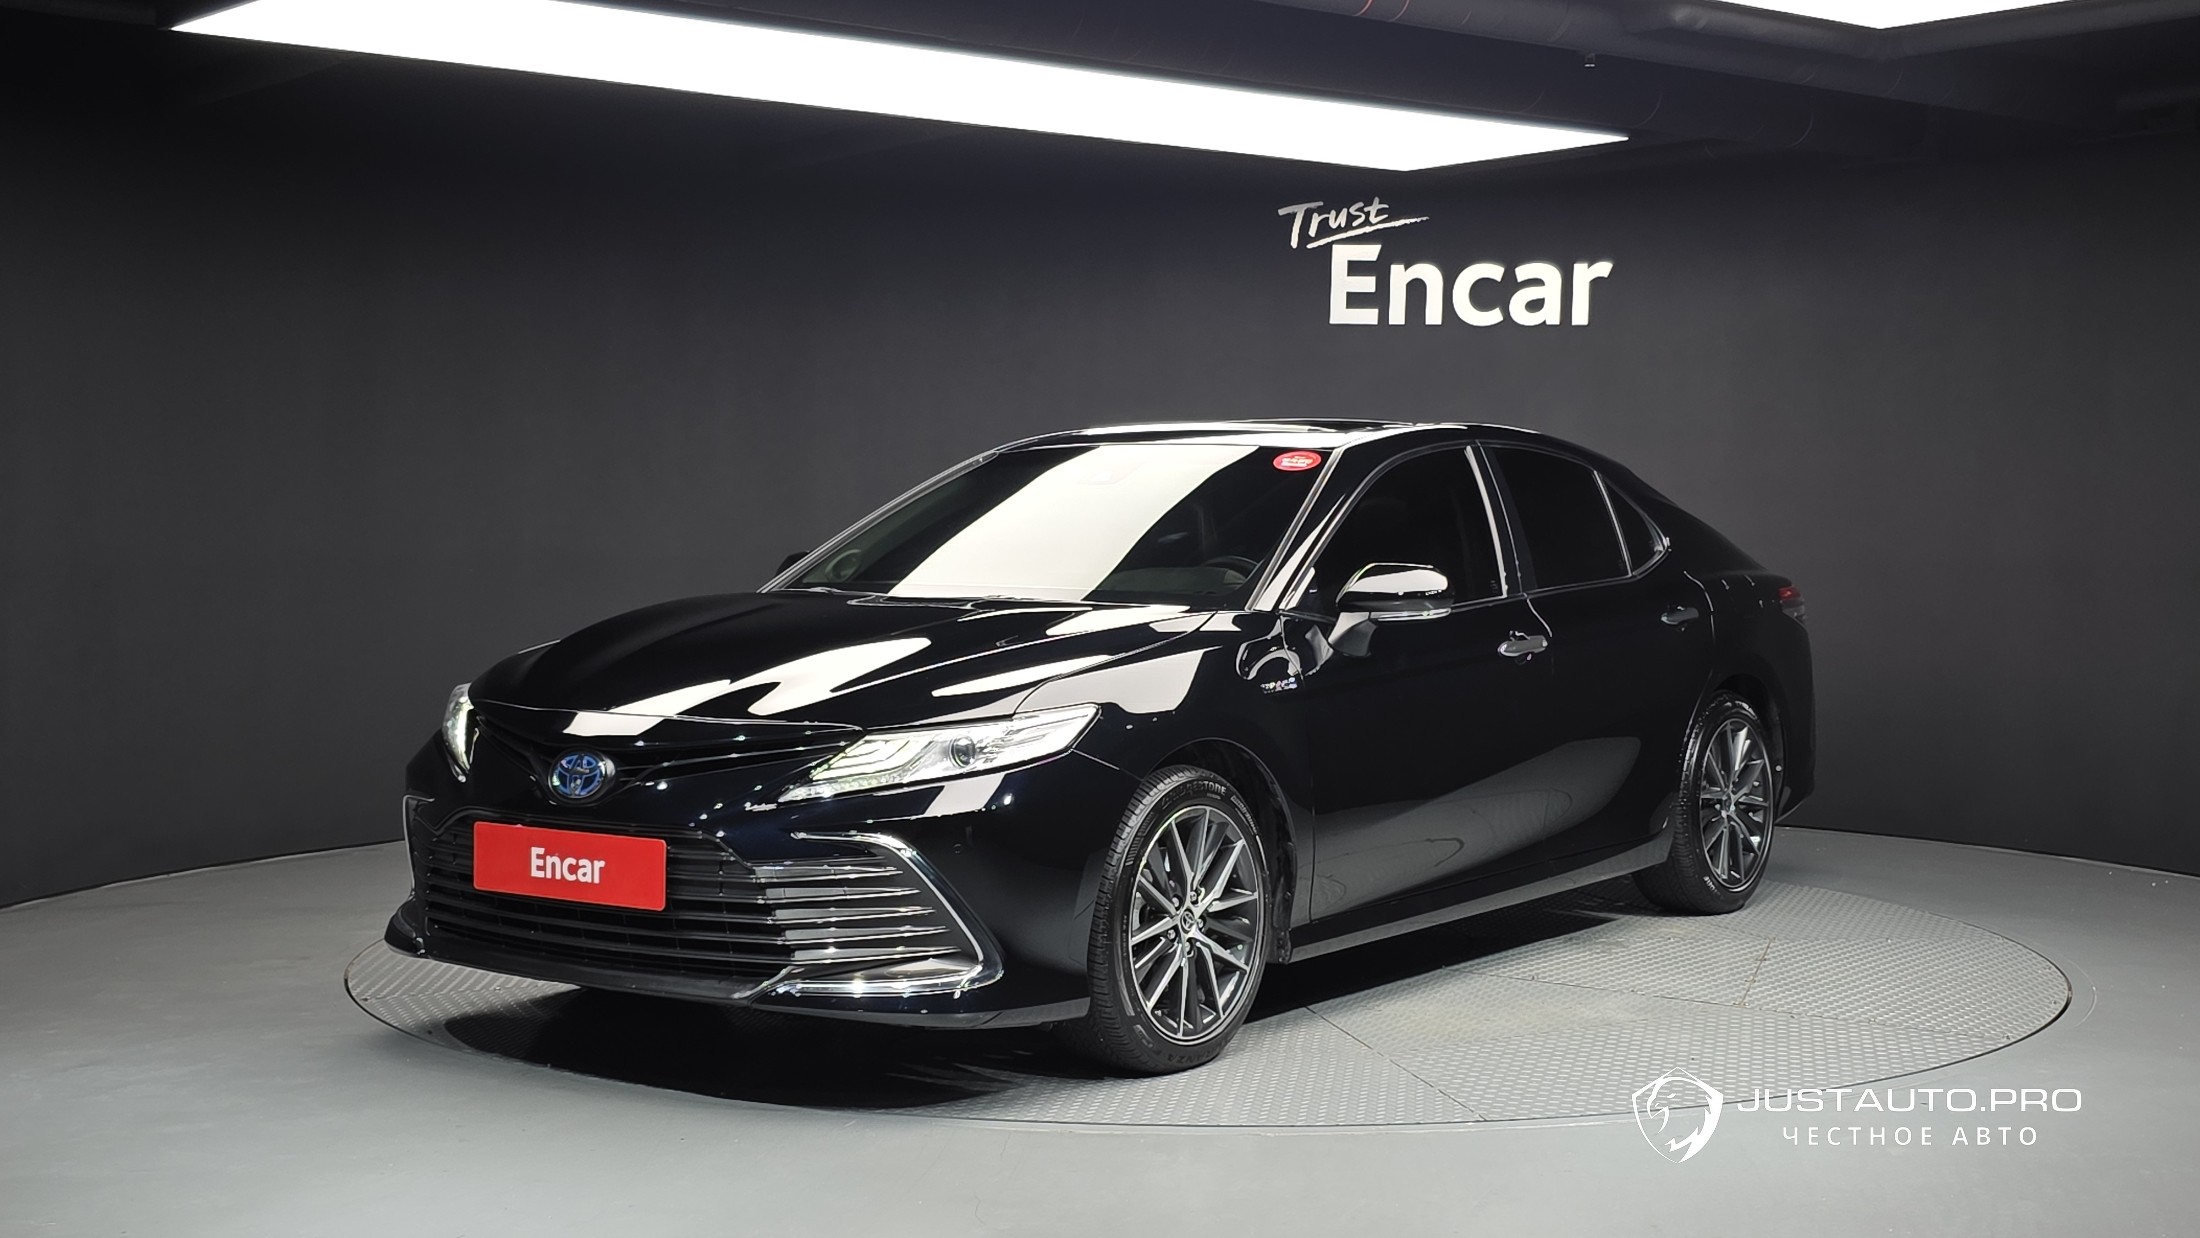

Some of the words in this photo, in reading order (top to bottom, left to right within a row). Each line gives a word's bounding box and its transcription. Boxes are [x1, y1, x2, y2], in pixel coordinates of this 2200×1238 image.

[1277, 197, 1390, 249] Trust
[1328, 243, 1614, 327] Encar
[530, 846, 606, 884] Encar
